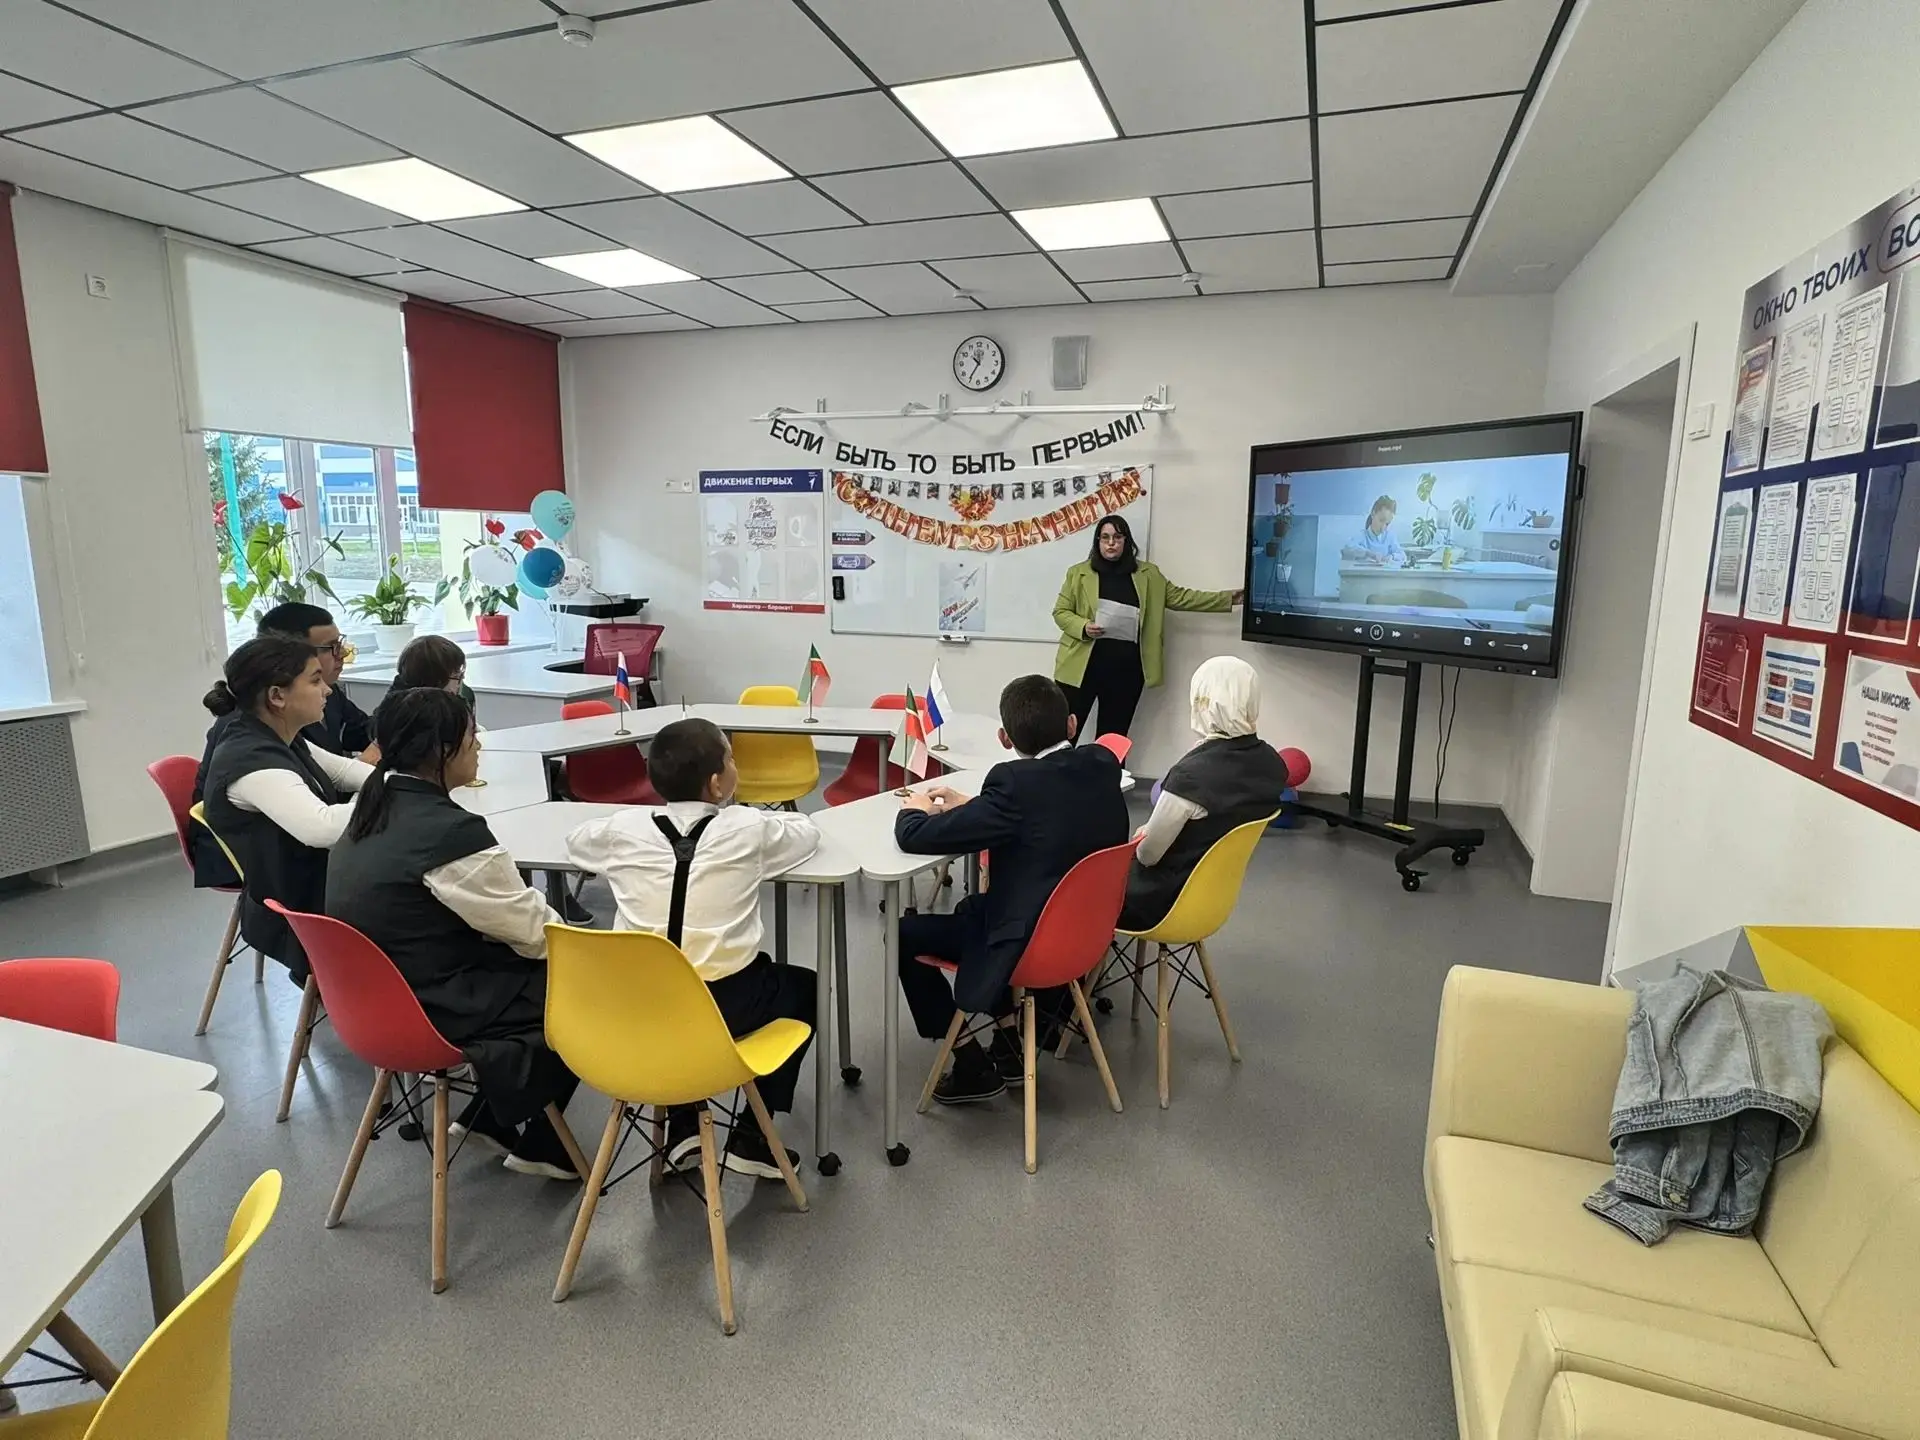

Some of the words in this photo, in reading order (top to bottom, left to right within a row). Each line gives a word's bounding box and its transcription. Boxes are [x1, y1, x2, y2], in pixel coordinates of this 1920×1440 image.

[1753, 287, 1797, 331] ОКНО
[1802, 243, 1872, 305] ТВОИХ
[769, 419, 825, 455] ЕСЛИ
[835, 442, 897, 472] БЫТЬ
[907, 453, 937, 475] ТО
[952, 452, 1016, 475] БЫТЬ
[1032, 411, 1146, 466] ПЕРВЫМ!
[703, 477, 754, 488] ДВИЖЕНИЕ
[755, 476, 794, 486] ПЕРВЫХ
[836, 478, 853, 503] С
[1861, 685, 1880, 702] НАША
[1880, 690, 1911, 711] МИССИЯ:
